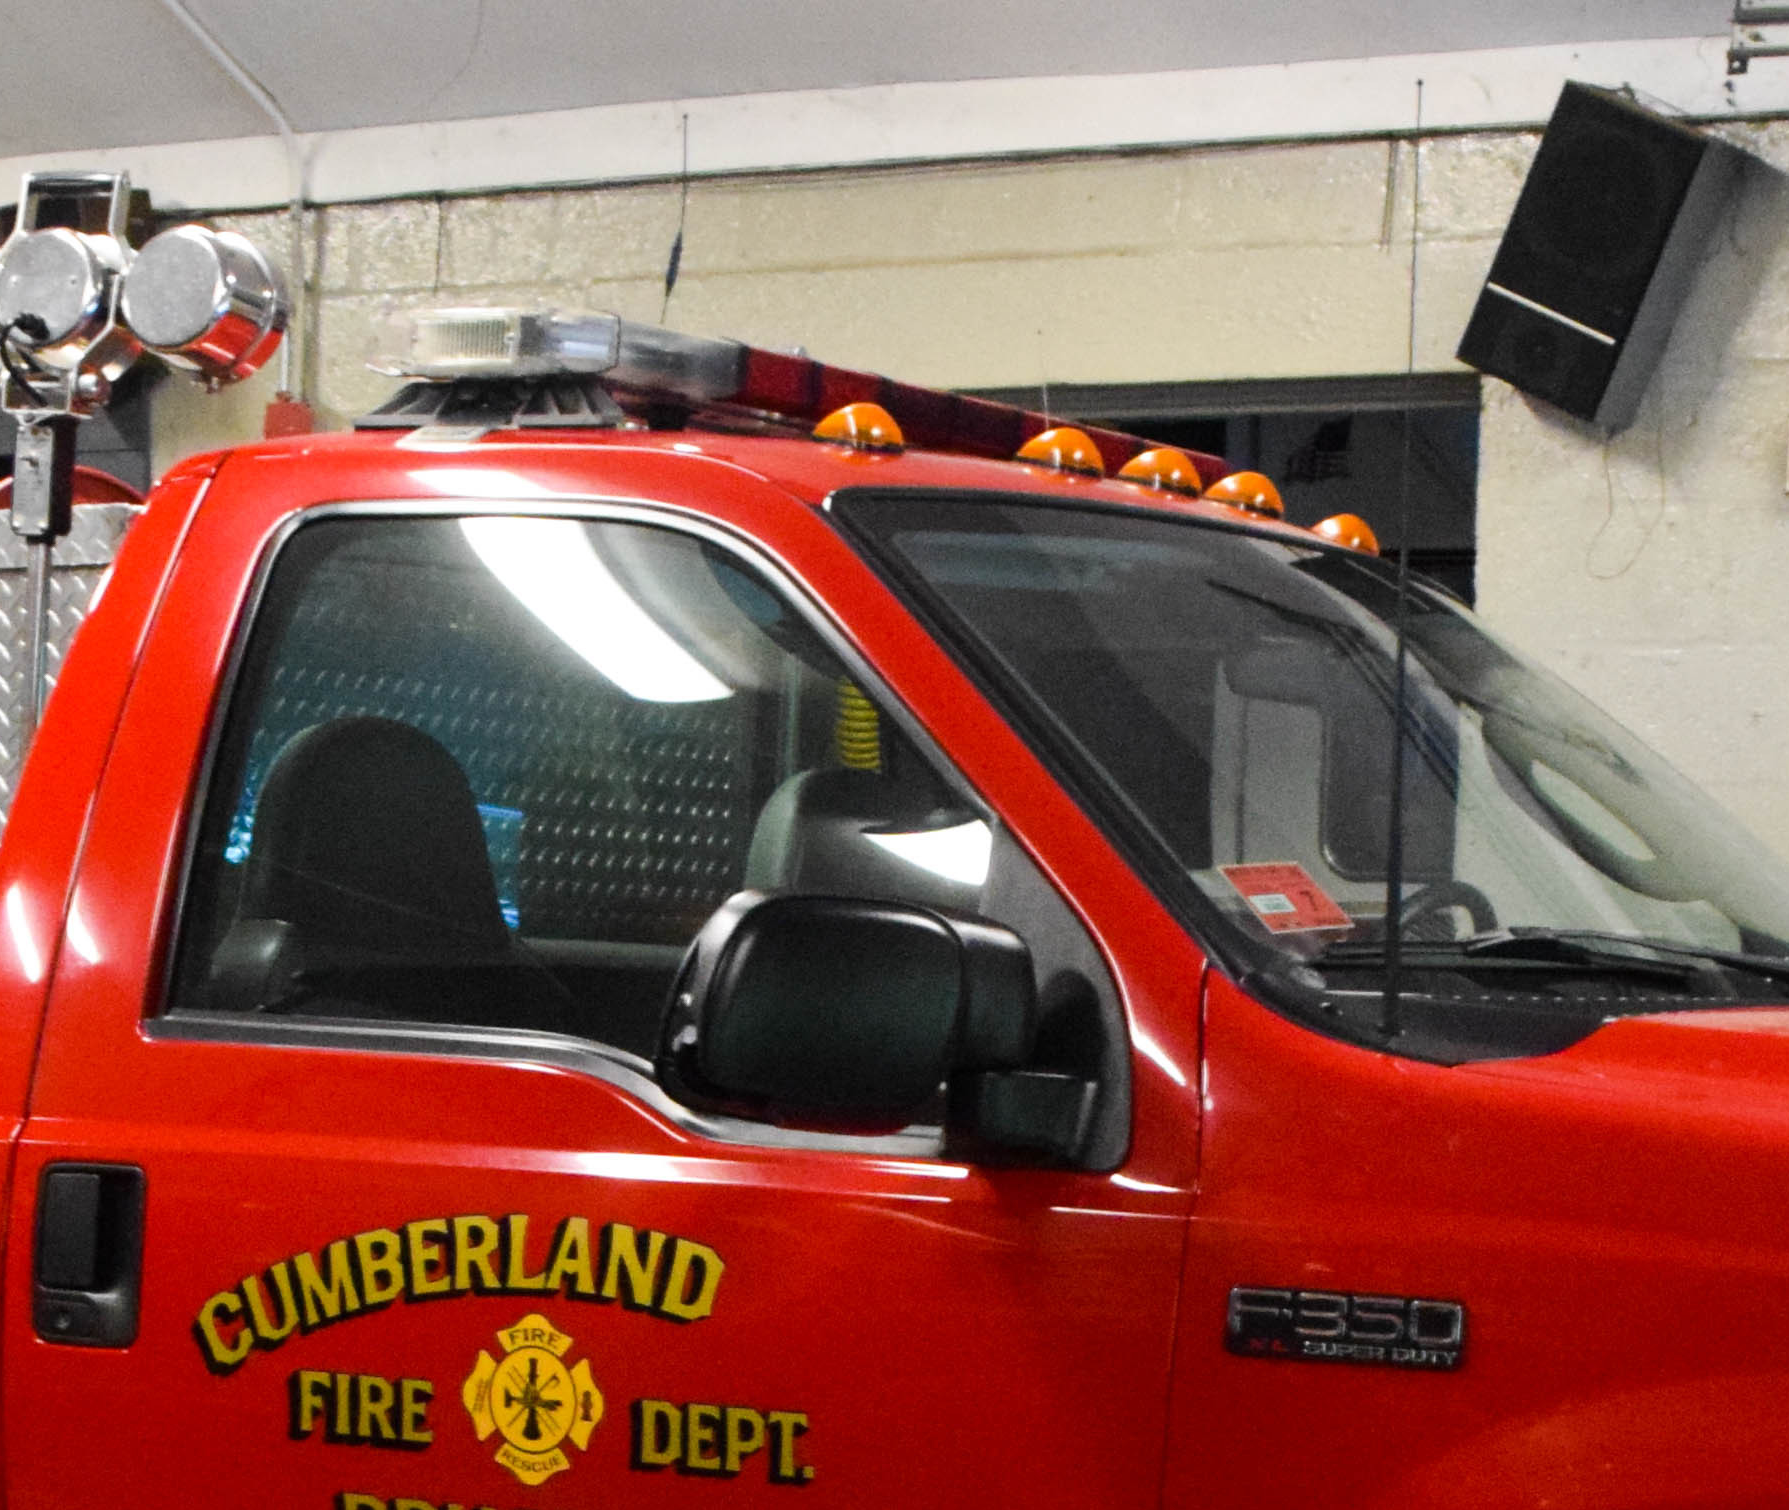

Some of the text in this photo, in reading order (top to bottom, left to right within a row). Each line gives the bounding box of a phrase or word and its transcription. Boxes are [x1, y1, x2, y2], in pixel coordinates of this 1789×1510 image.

[194, 1214, 725, 1370] CUMBERLAND
[509, 1328, 561, 1349] FIRE
[1303, 1340, 1385, 1360] SUPER
[1392, 1348, 1457, 1365] DUTY
[294, 1371, 815, 1480] FIRE DEPT.
[503, 1451, 561, 1472] RESCUE
